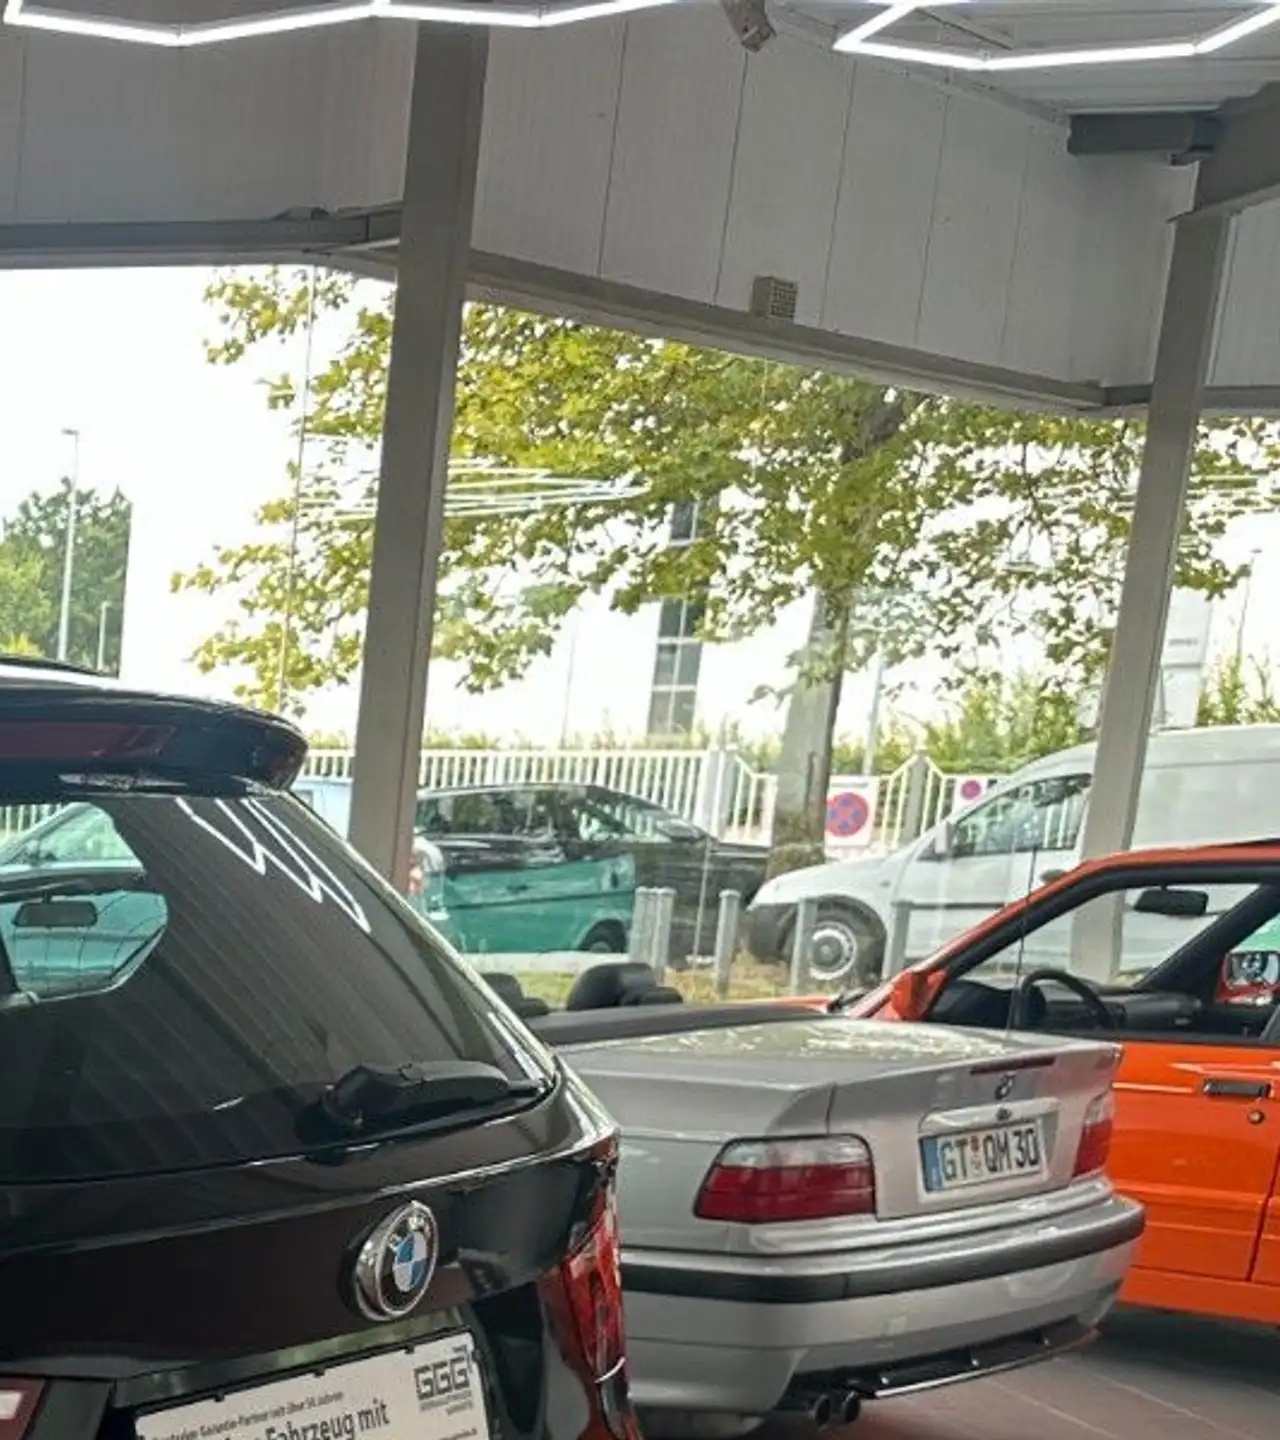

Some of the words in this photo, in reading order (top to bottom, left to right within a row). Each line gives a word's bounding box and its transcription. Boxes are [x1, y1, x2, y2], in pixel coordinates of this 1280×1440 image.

[941, 1138, 969, 1181] GT
[1013, 1127, 1040, 1168] 30
[414, 1355, 471, 1400] GGG
[358, 1398, 390, 1432] mit
